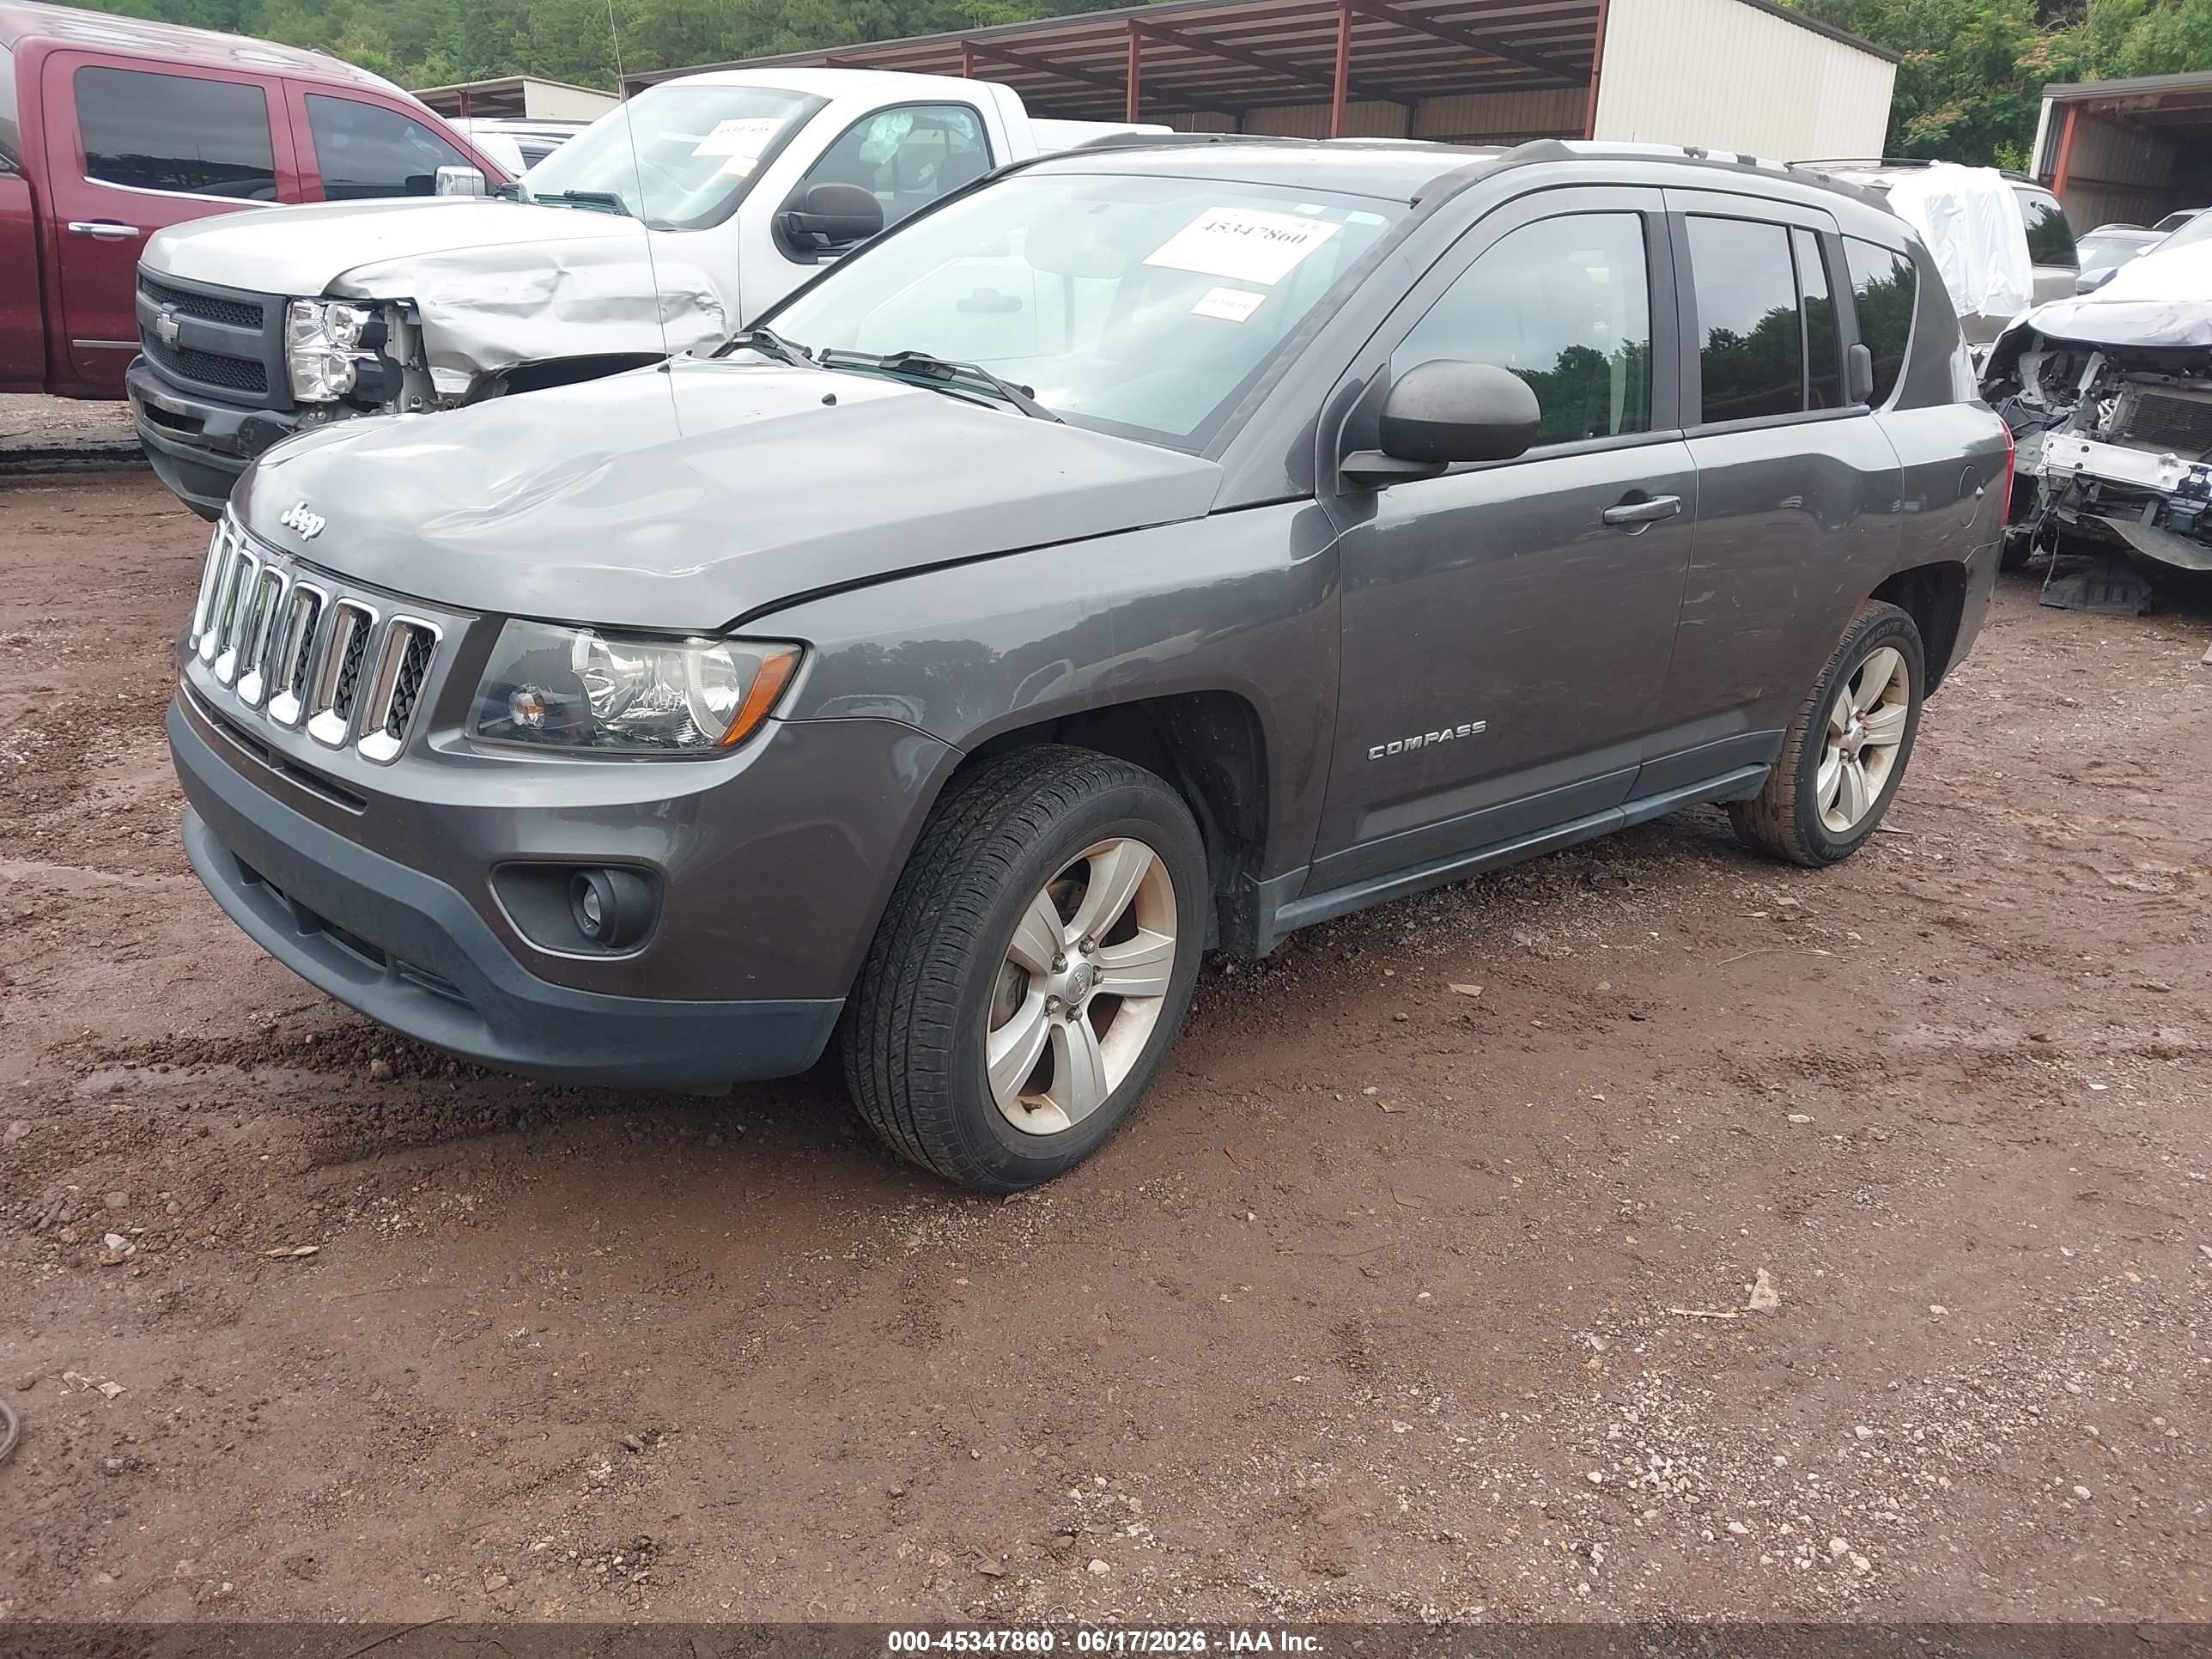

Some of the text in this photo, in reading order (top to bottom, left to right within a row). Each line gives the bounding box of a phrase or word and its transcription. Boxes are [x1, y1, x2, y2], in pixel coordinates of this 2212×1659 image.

[1201, 220, 1309, 246] 45347860
[280, 501, 326, 542] Jeep
[1367, 720, 1487, 761] COMPASS
